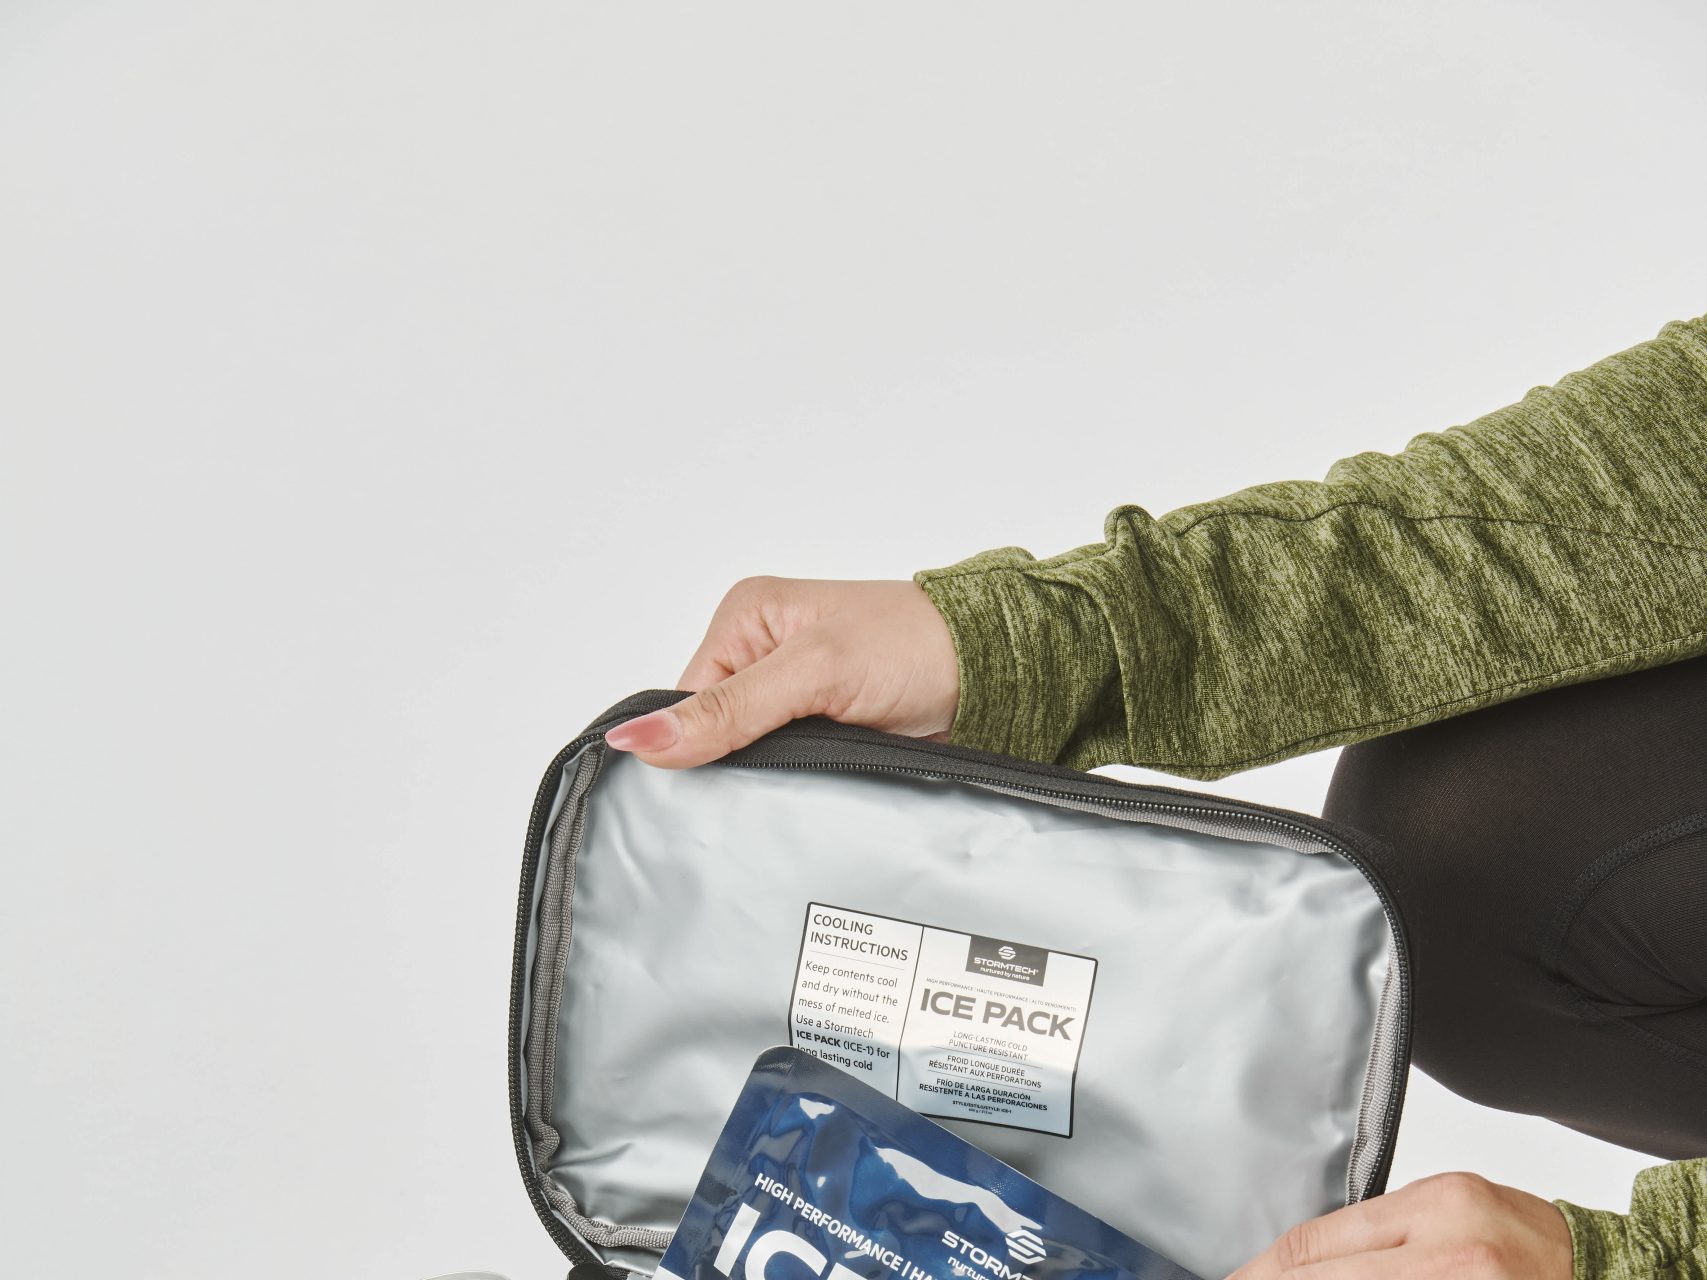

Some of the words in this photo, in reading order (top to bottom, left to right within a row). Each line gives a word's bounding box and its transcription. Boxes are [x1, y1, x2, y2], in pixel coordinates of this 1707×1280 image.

[813, 914, 873, 935] COOLING
[810, 931, 909, 961] INSTRUCTIONS
[805, 960, 830, 976] Keep
[832, 968, 875, 984] contents
[877, 977, 898, 988] cool
[979, 966, 1004, 977] nurtured
[1004, 969, 1012, 978] by
[1011, 972, 1031, 981] nature
[801, 980, 821, 991] and
[822, 982, 840, 997] dry
[842, 987, 880, 1003] without
[881, 994, 898, 1007] the
[938, 980, 974, 992] PERFORMANCE
[993, 991, 1028, 1002] PERFORMANCE
[798, 998, 823, 1010] mess
[825, 1001, 836, 1012] of
[837, 1006, 872, 1020] melted
[873, 1012, 890, 1024] ice.
[920, 987, 976, 1021] ICE
[982, 1000, 1075, 1041] PACK
[796, 1013, 814, 1027] Use
[815, 1020, 822, 1028] a
[823, 1019, 874, 1039] Stormtech
[796, 1029, 812, 1041] ICE
[813, 1033, 841, 1048] PACK
[843, 1040, 875, 1056] (ICE-1)
[876, 1047, 891, 1059] for
[948, 1039, 987, 1053] PUNCTURE
[988, 1047, 1028, 1061] RESISTANT
[953, 1031, 1007, 1048] LONG-LASTING
[1007, 1041, 1028, 1052] COLD
[819, 1050, 851, 1068] lasting
[853, 1059, 873, 1071] cold
[947, 1055, 969, 1065] FROID
[970, 1059, 1000, 1073] LONGUE
[1001, 1064, 1025, 1077] DURÉE
[928, 1059, 968, 1074] RÉSISTANT
[969, 1068, 985, 1078] AUX
[986, 1071, 1042, 1089] PERFORATIONS
[919, 1083, 963, 1097] RESISTENTE
[964, 1090, 970, 1098] A
[971, 1091, 986, 1101] LAS
[987, 1095, 1048, 1111] PERFORACIONES
[936, 1078, 953, 1088] FRÍO
[954, 1081, 965, 1090] DE
[966, 1082, 991, 1094] LARGA
[992, 1088, 1031, 1101] DURACIÓN
[754, 1172, 794, 1205] HIGH
[793, 1197, 904, 1271] PERFORMANCE
